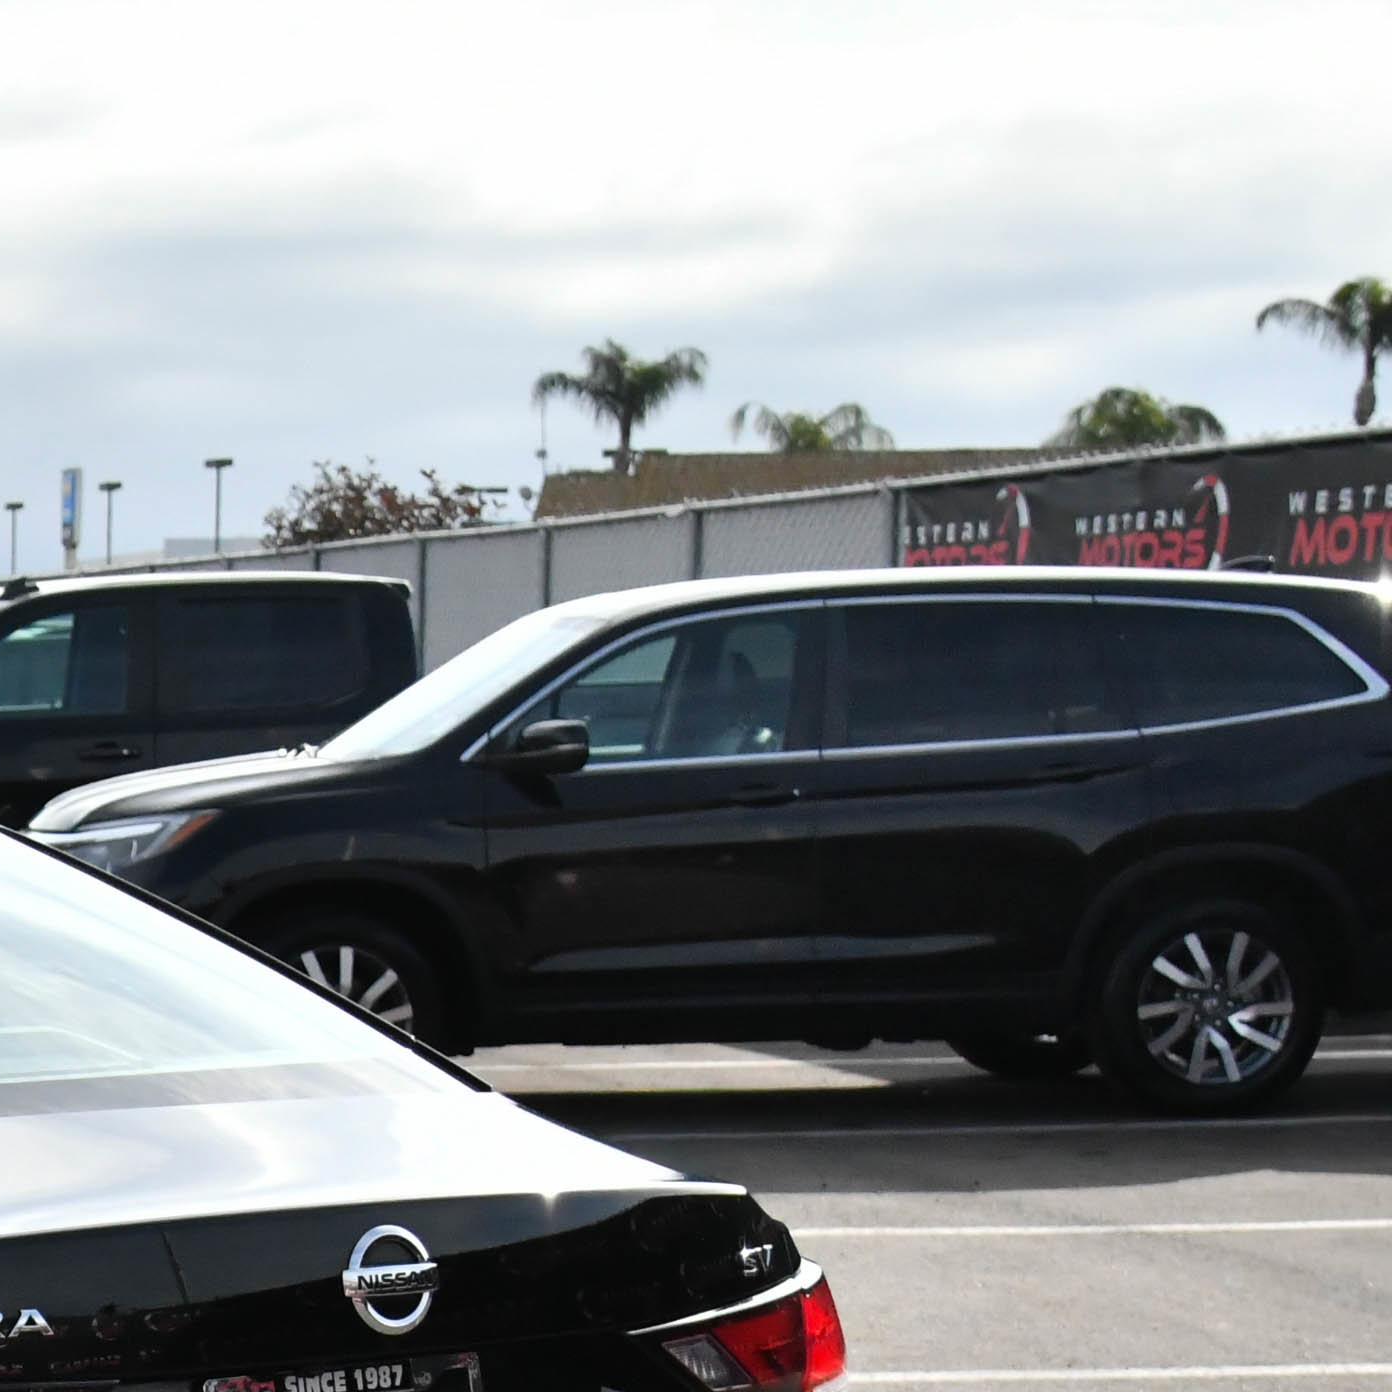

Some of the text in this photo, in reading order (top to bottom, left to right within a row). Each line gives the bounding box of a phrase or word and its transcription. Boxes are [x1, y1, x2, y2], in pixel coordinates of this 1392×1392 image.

[903, 520, 990, 546] ESTERN
[1075, 508, 1185, 536] WESTERN
[1078, 527, 1207, 568] MOTORS
[353, 1364, 404, 1391] 1987
